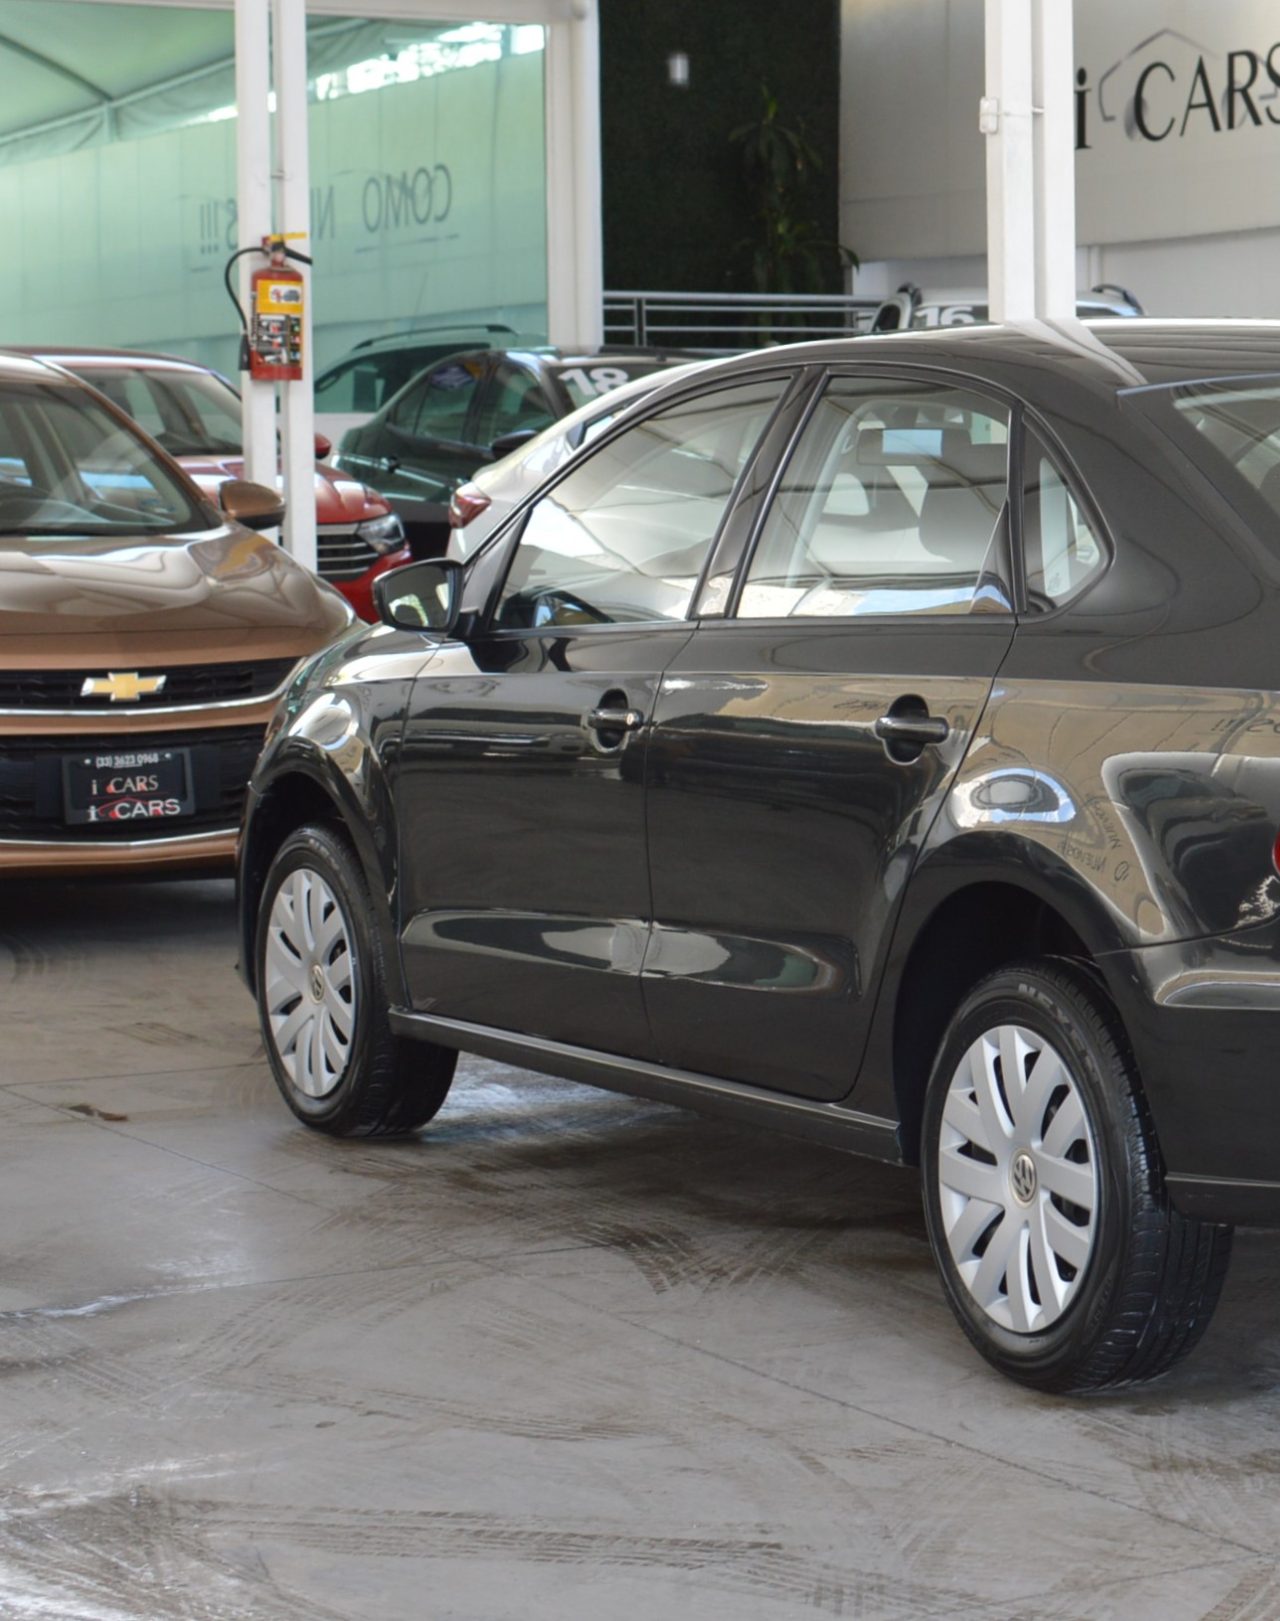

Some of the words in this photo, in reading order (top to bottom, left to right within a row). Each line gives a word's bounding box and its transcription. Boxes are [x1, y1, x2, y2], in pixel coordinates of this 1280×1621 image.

[557, 367, 630, 397] 18
[109, 774, 159, 793] CARS
[115, 798, 181, 819] CARS
